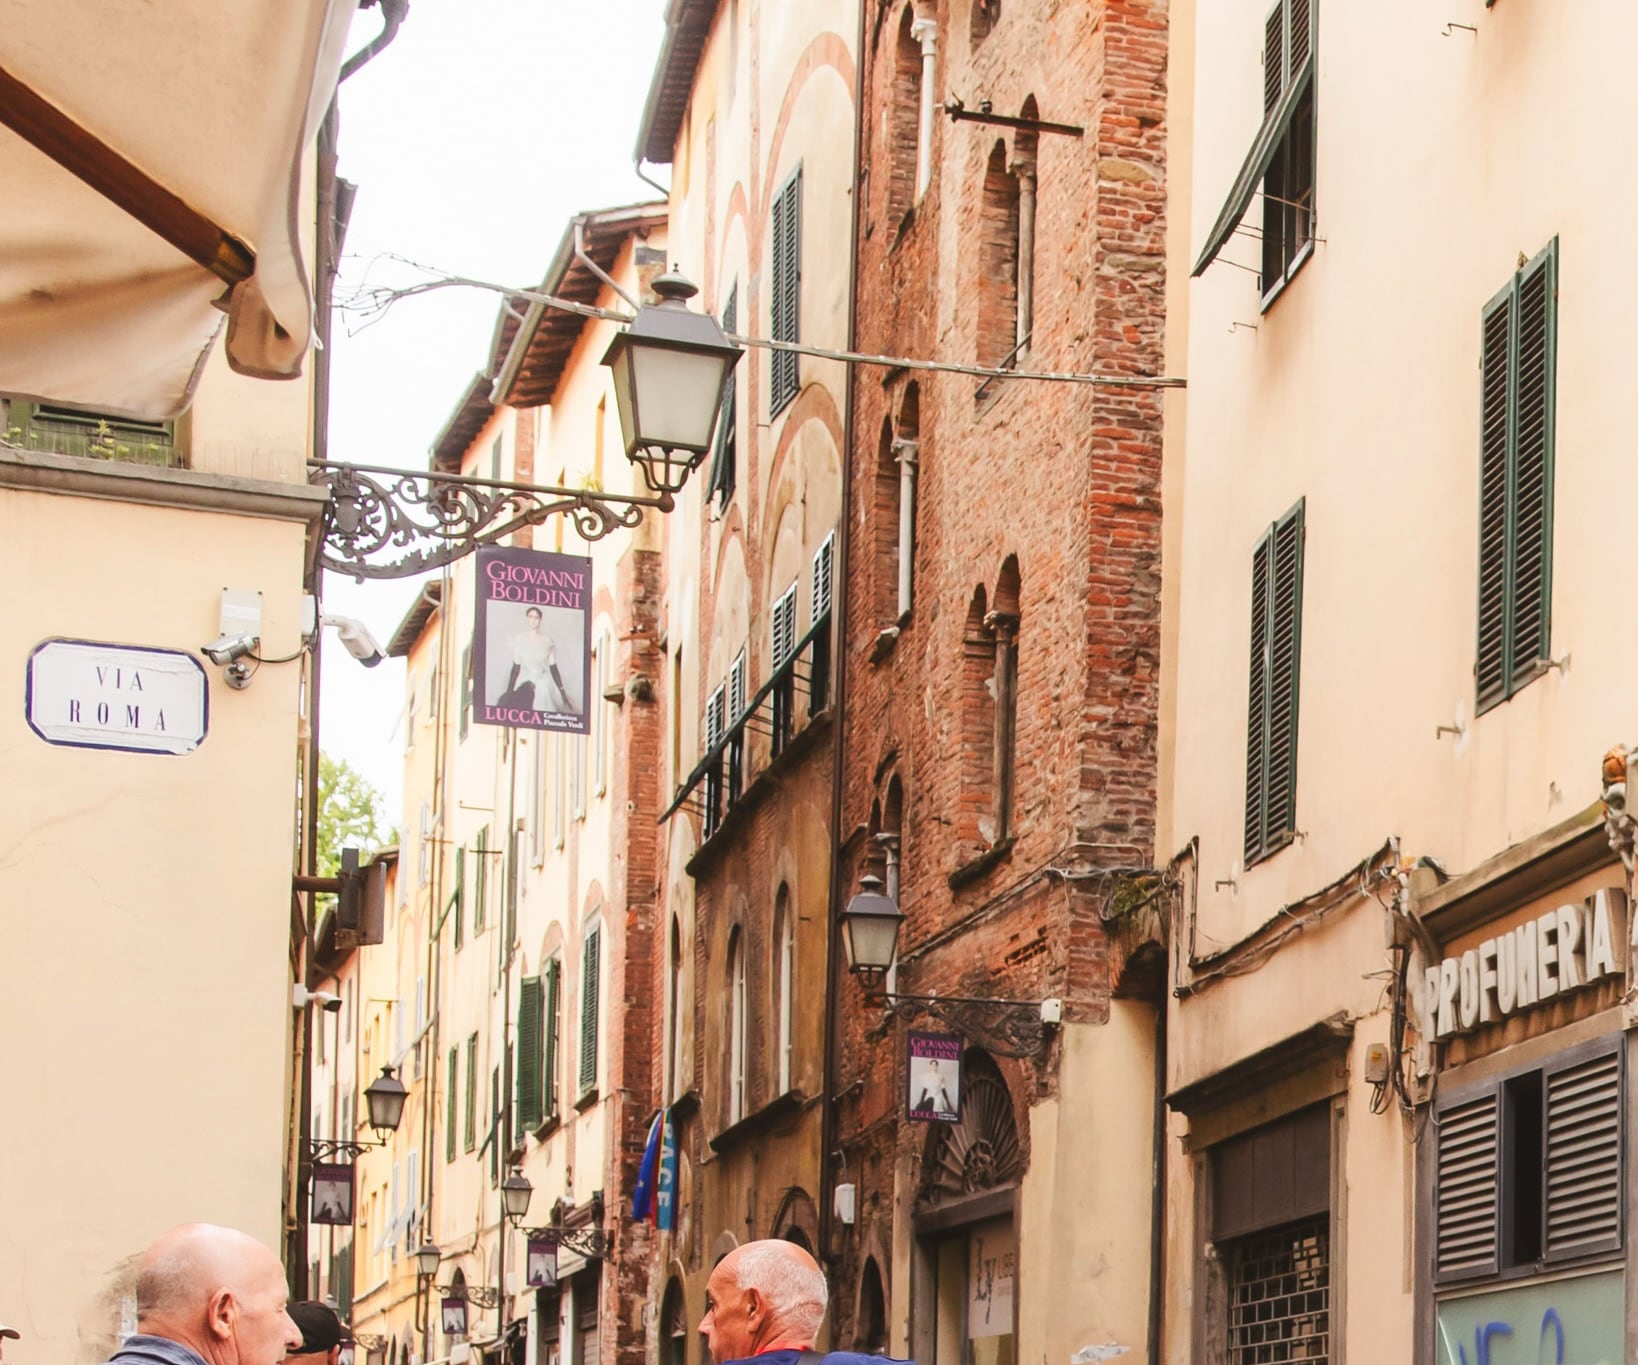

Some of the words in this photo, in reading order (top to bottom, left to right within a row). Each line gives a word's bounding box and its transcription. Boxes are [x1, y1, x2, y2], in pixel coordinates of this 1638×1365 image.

[486, 560, 584, 590] GIOVANNI
[490, 580, 581, 608] BOLDINI
[96, 666, 143, 691] VIA
[70, 699, 165, 731] ROMA
[485, 706, 542, 725] LUCCA
[1425, 887, 1624, 1042] PROFUMERIA
[657, 1122, 674, 1207] PACE
